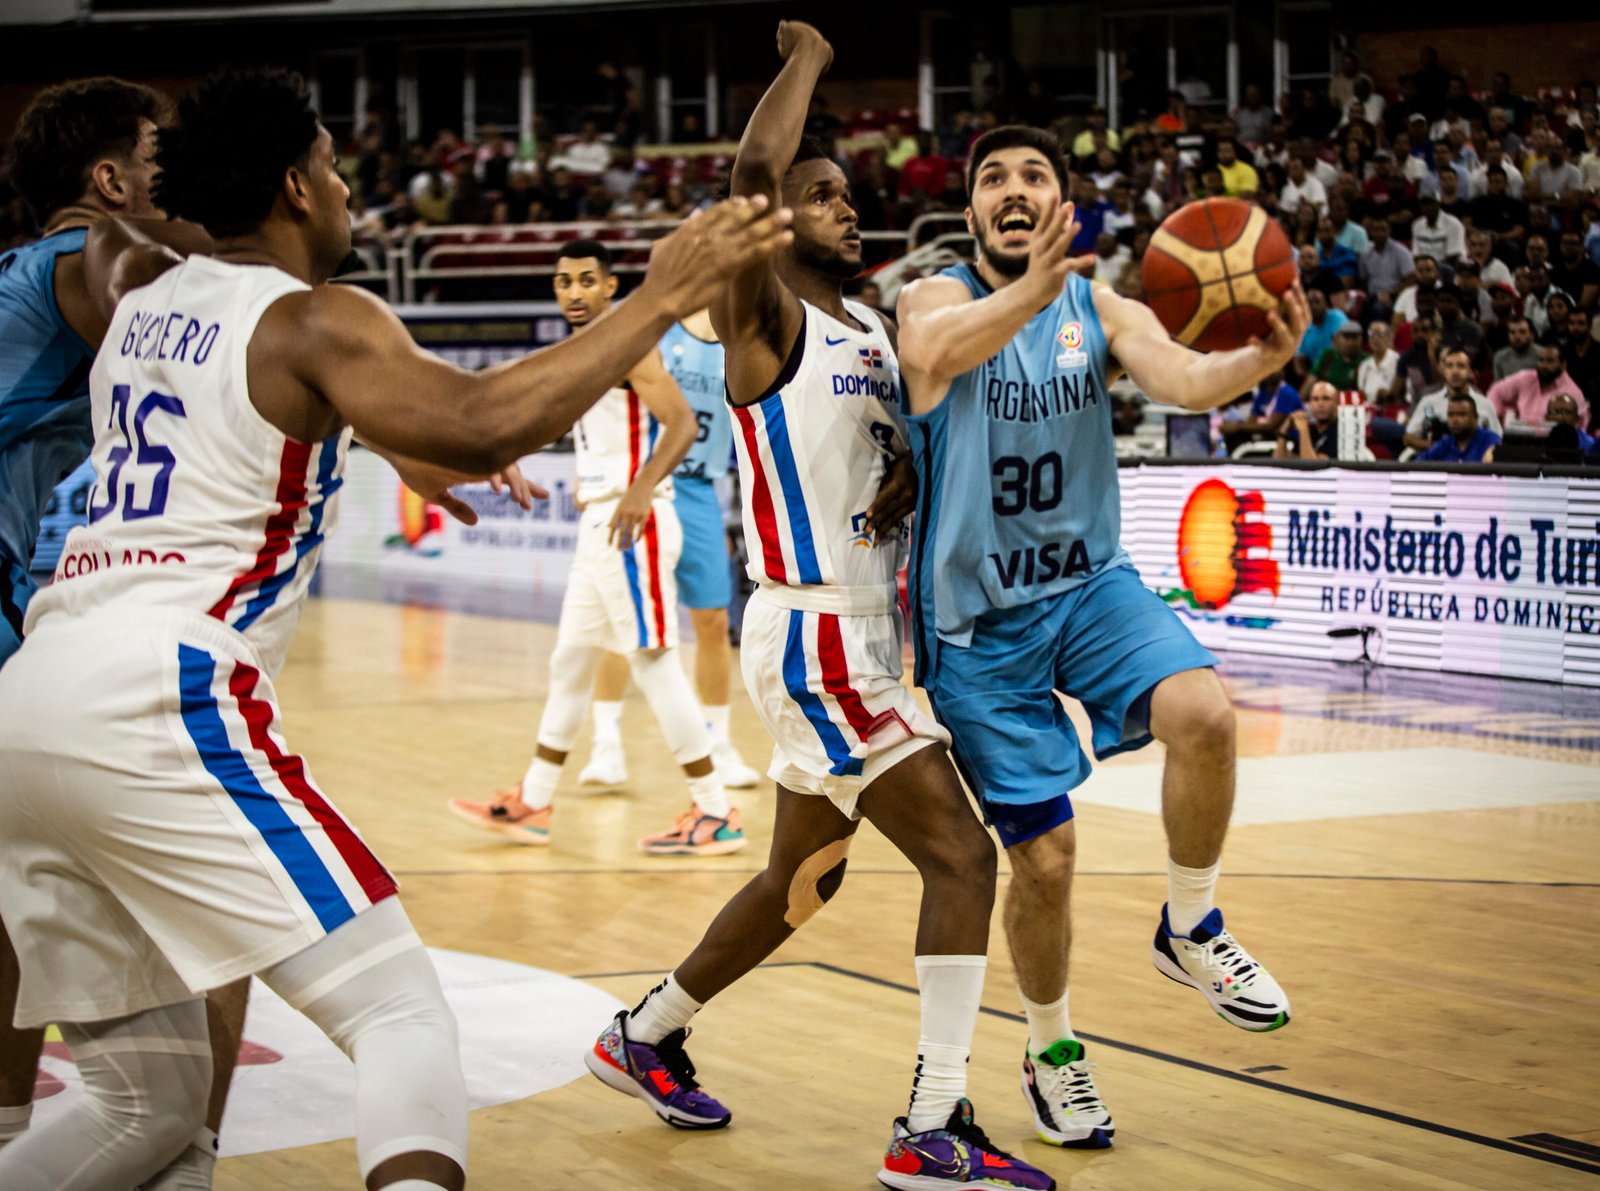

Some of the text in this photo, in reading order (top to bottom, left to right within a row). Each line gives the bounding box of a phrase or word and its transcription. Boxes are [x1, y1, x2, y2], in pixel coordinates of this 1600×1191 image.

[88, 384, 187, 525] 35
[992, 450, 1063, 517] 30
[988, 538, 1093, 590] VISA
[1288, 509, 1465, 578] Ministerio
[1475, 517, 1522, 583] de
[1322, 578, 1600, 634] REPÚBLICA DOMINIC
